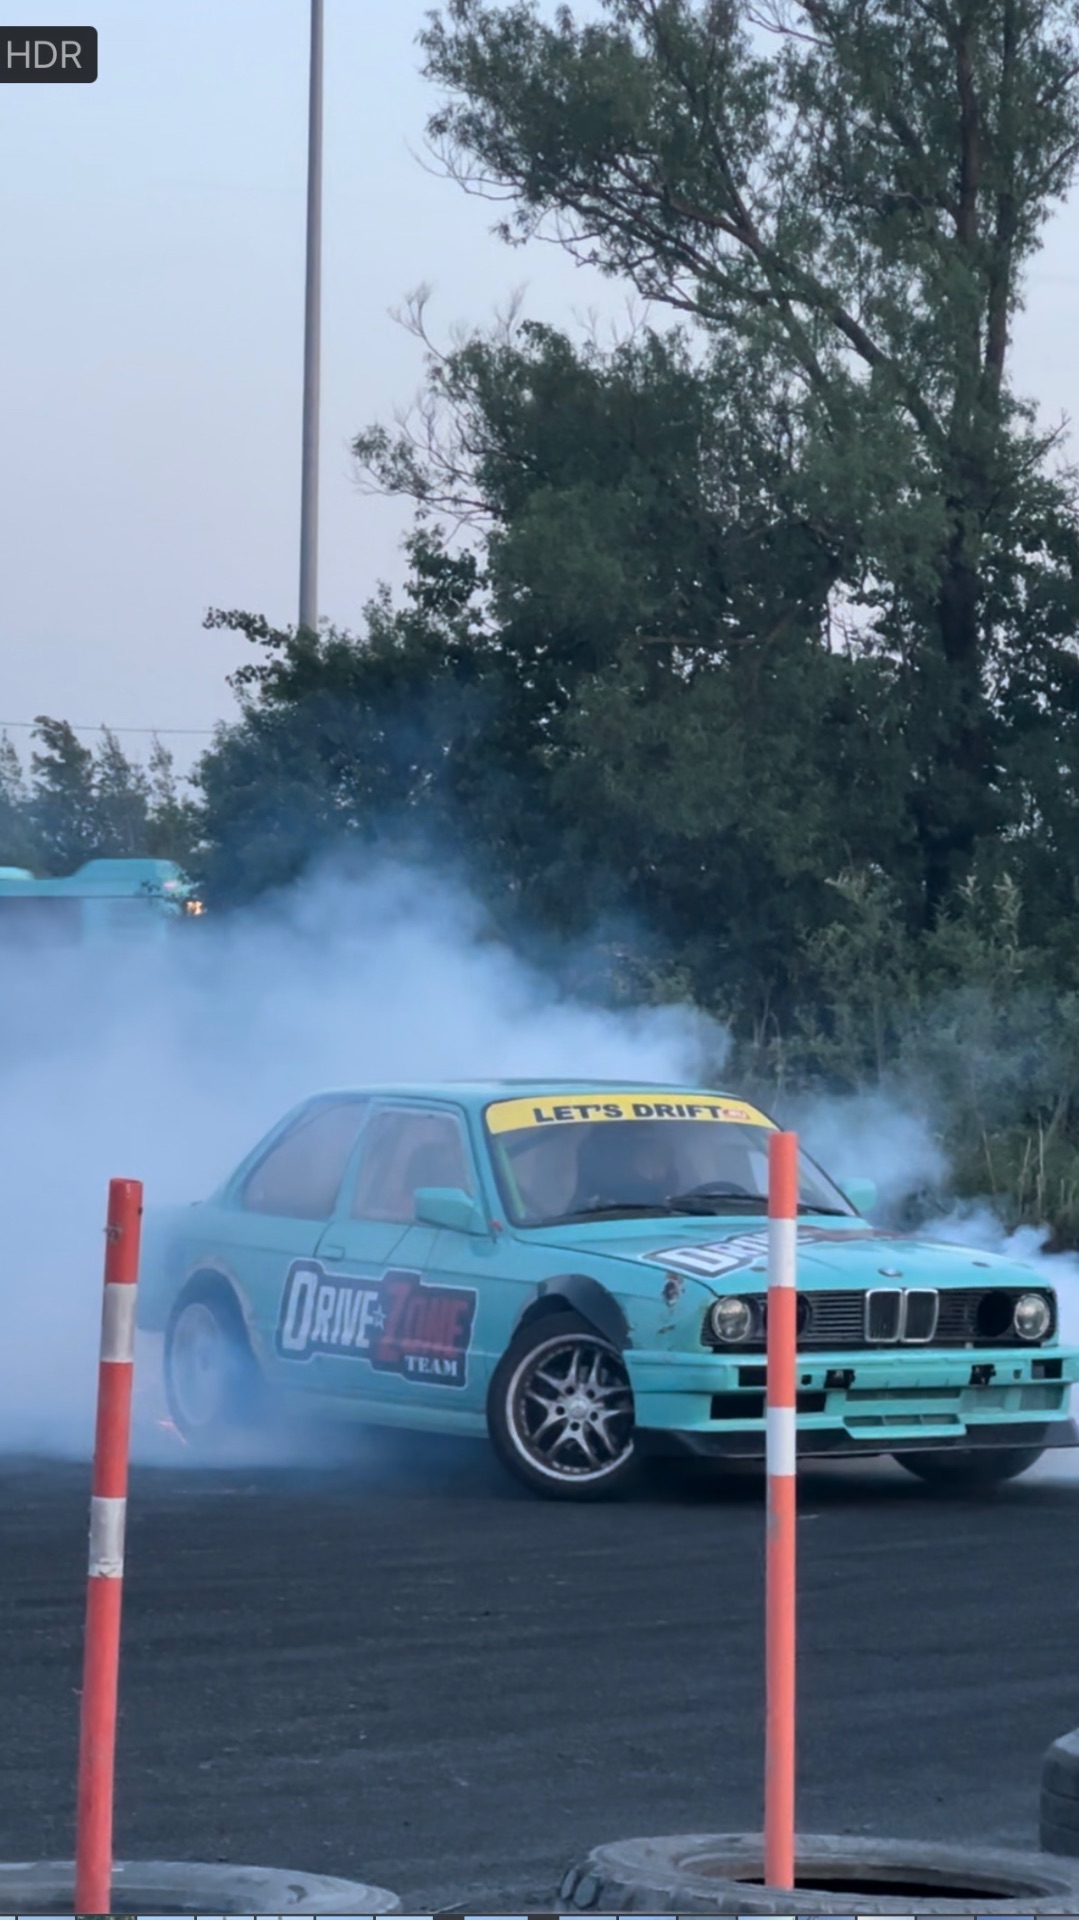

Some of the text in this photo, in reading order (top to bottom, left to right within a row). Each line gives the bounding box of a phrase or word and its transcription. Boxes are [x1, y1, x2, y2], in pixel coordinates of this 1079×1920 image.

[533, 1103, 624, 1123] LET'S
[632, 1103, 722, 1119] DRIFT
[282, 1270, 379, 1351] DRIVE
[404, 1355, 458, 1377] TEAM
